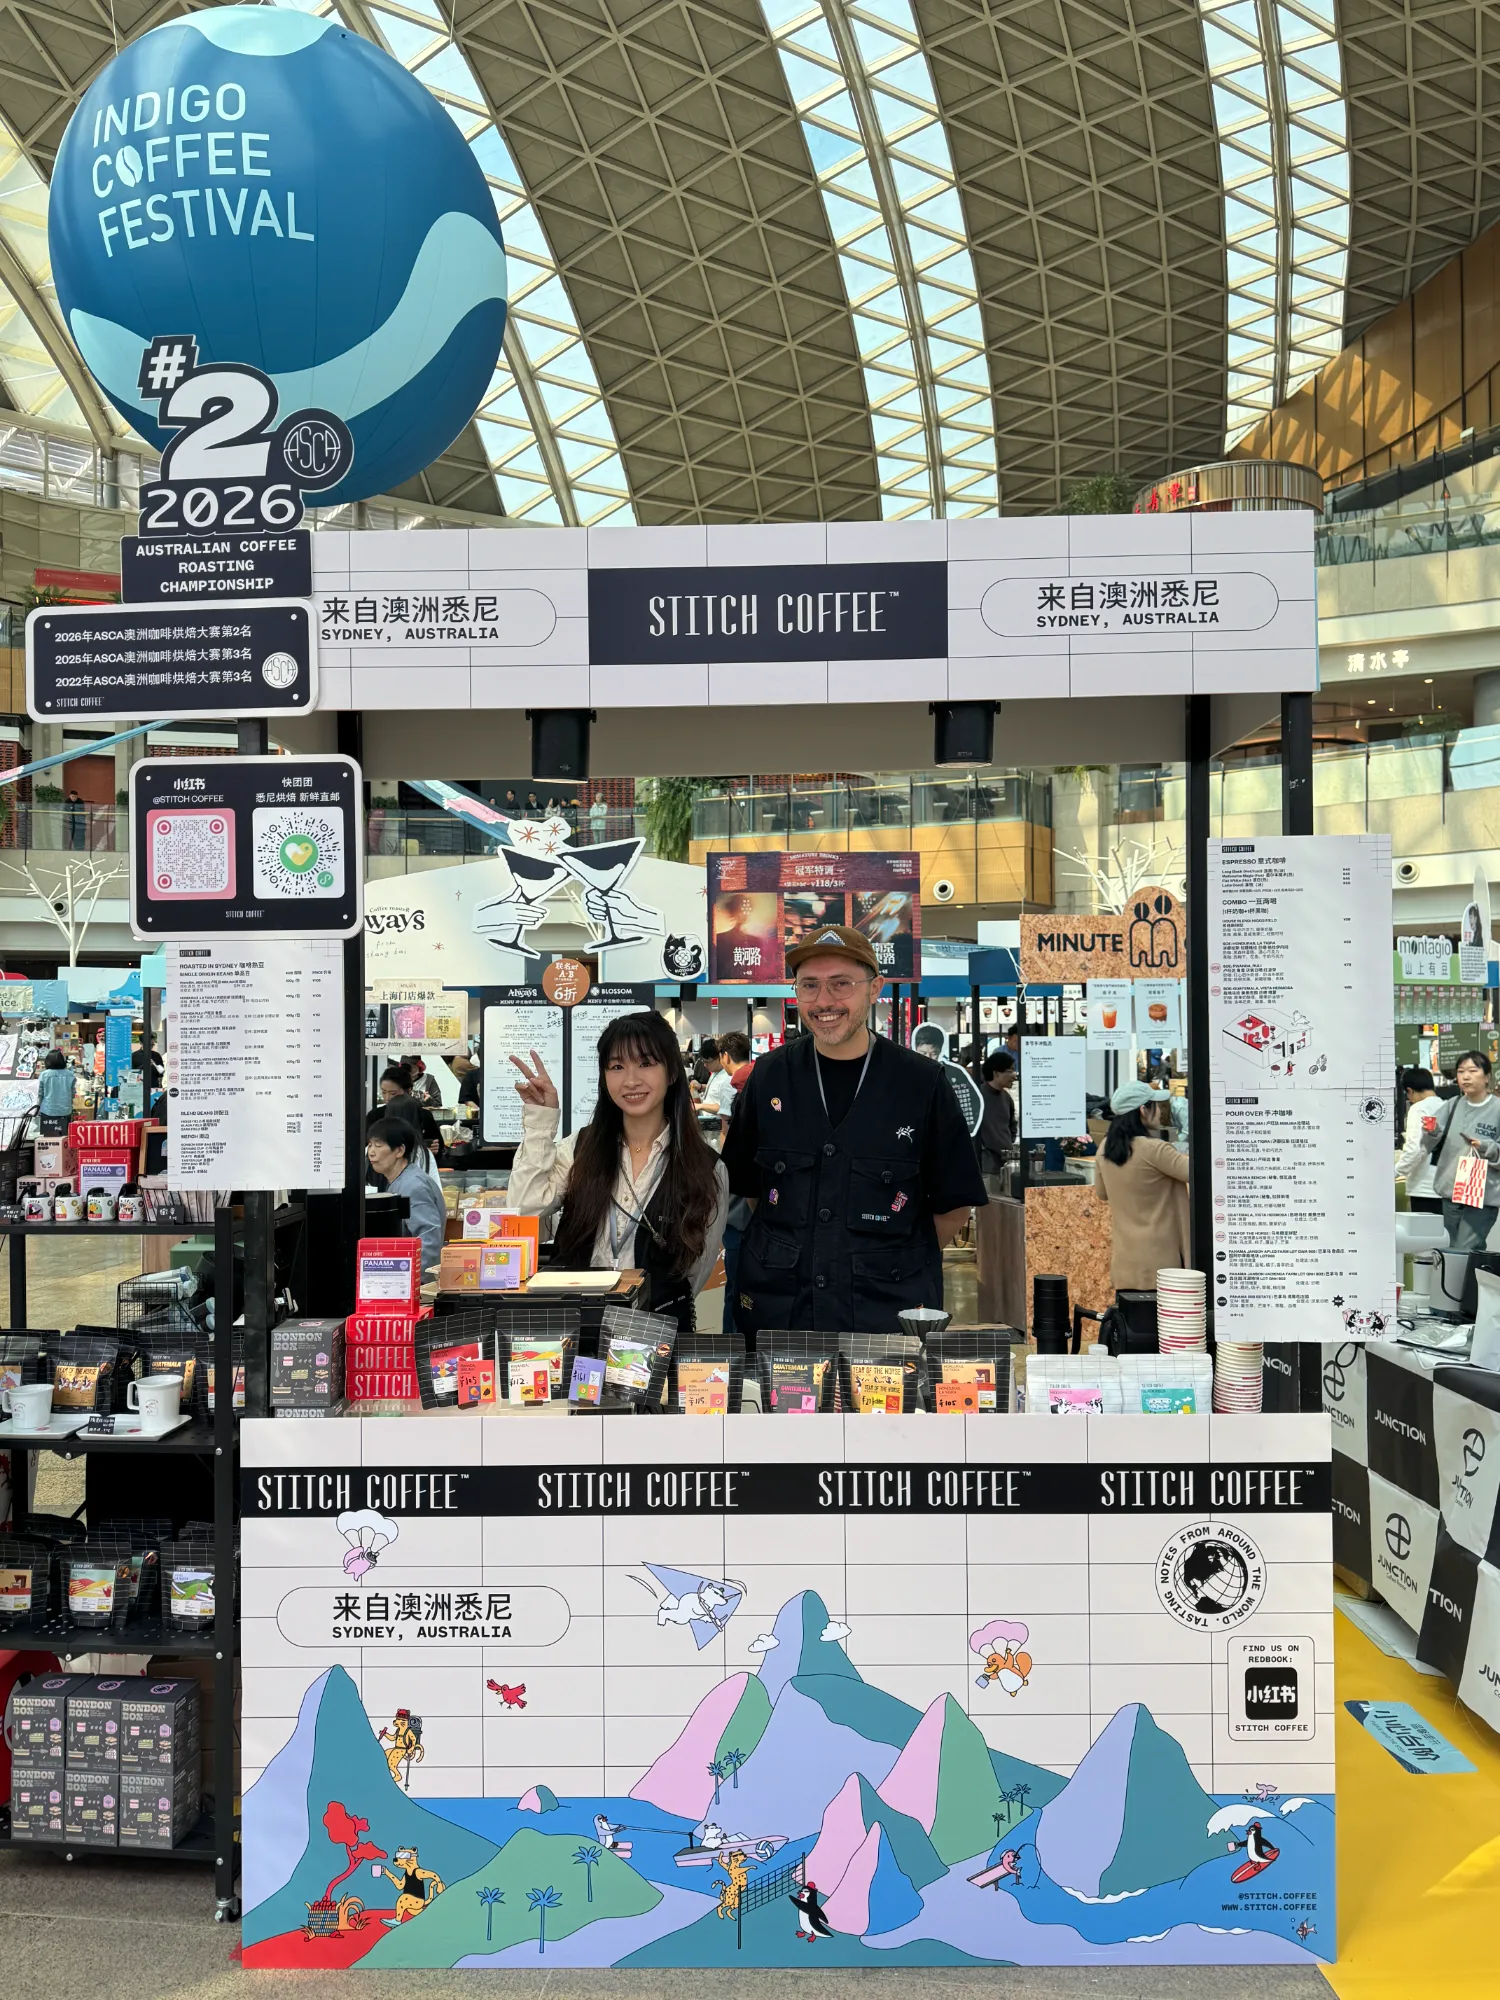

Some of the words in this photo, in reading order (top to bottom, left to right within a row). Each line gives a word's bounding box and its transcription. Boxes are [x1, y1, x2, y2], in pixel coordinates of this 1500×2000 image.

[93, 83, 246, 148] INDIGO
[92, 132, 271, 197] COFFEE
[99, 187, 314, 257] FESTIVAL
[283, 425, 341, 474] ASCA
[147, 484, 296, 528] 2026
[136, 541, 231, 556] AUSTRALIAN
[240, 539, 297, 552] COFFEE
[178, 560, 255, 573] ROASTING
[160, 578, 274, 593] CHAMPIONSHIP
[1037, 580, 1219, 611] 来自澳洲悉尼
[322, 595, 500, 624] 来自澳洲悉尼
[649, 594, 757, 637] STITCH
[1036, 615, 1109, 629] SYDNEY,
[1122, 611, 1219, 625] AUSTRALIA
[55, 625, 252, 642] 2026年ASCA澳洲咖啡烘焙大赛第2名
[321, 628, 392, 642] SYDNEY,
[405, 627, 499, 640] AUSTRALIA
[55, 647, 252, 664] 2025年ASCA澳洲咖啡烘焙大赛第3名
[1347, 649, 1410, 672] 清水亭
[55, 670, 252, 687] 2022年ASCA澳洲咖啡烘焙大赛第3名
[173, 778, 205, 790] 小红书
[281, 777, 313, 788] 快团团
[153, 795, 190, 804] @STITCH
[191, 794, 224, 803] COFFEE
[255, 792, 296, 803] 悉尼烘焙
[299, 791, 340, 802] 新鲜直邮
[364, 909, 425, 934] ways
[1037, 933, 1123, 952] MINUTE
[1399, 936, 1451, 958] montagio
[733, 946, 761, 966] 黄河路
[380, 991, 436, 1000] 上海门店爆款
[508, 988, 538, 998] Always
[554, 987, 577, 1001] 6折
[76, 1124, 129, 1146] STITCH
[273, 1333, 323, 1342] BONBON
[354, 1319, 413, 1342] STITCH
[273, 1342, 298, 1351] BOX
[354, 1346, 412, 1369] COFFEE
[853, 1366, 865, 1374] YEAR
[354, 1374, 412, 1397] STITCH
[276, 1408, 325, 1417] BONBON
[1374, 1409, 1427, 1446] JUNCTION
[257, 1473, 350, 1511] STITCH
[538, 1471, 631, 1509] STITCH
[818, 1470, 911, 1508] STITCH
[1101, 1470, 1194, 1506] STITCH
[1180, 1526, 1210, 1544] FROM
[1217, 1527, 1256, 1561] AROUND
[1160, 1546, 1178, 1584] NOTES
[1377, 1554, 1418, 1594] JUNCTION
[1251, 1567, 1261, 1591] THE
[332, 1592, 512, 1622] 来自澳洲悉尼
[1164, 1591, 1209, 1627] TASTING
[1216, 1596, 1255, 1625] WORLD.
[1430, 1587, 1463, 1623] TION
[332, 1626, 404, 1641] SYDNEY,
[416, 1625, 512, 1639] AUSTRALIA
[13, 1698, 56, 1707] BONBON
[1247, 1685, 1296, 1703] 小红书
[13, 1707, 34, 1715] BOX
[68, 1700, 112, 1710] BONBON
[68, 1709, 90, 1717] BOX
[122, 1703, 165, 1713] BONBON
[122, 1712, 143, 1721] BOX
[1373, 1710, 1440, 1761] 小心台阶
[12, 1770, 55, 1779] BONBON
[12, 1779, 34, 1788] BOX
[66, 1774, 110, 1784] BONBON
[121, 1776, 165, 1786] BONBON
[66, 1783, 87, 1792] BOX
[121, 1785, 142, 1794] BOX
[1238, 1892, 1317, 1900] @STITCH.COFFEE
[1221, 1903, 1317, 1911] WWW.STITCH.COFFEE
